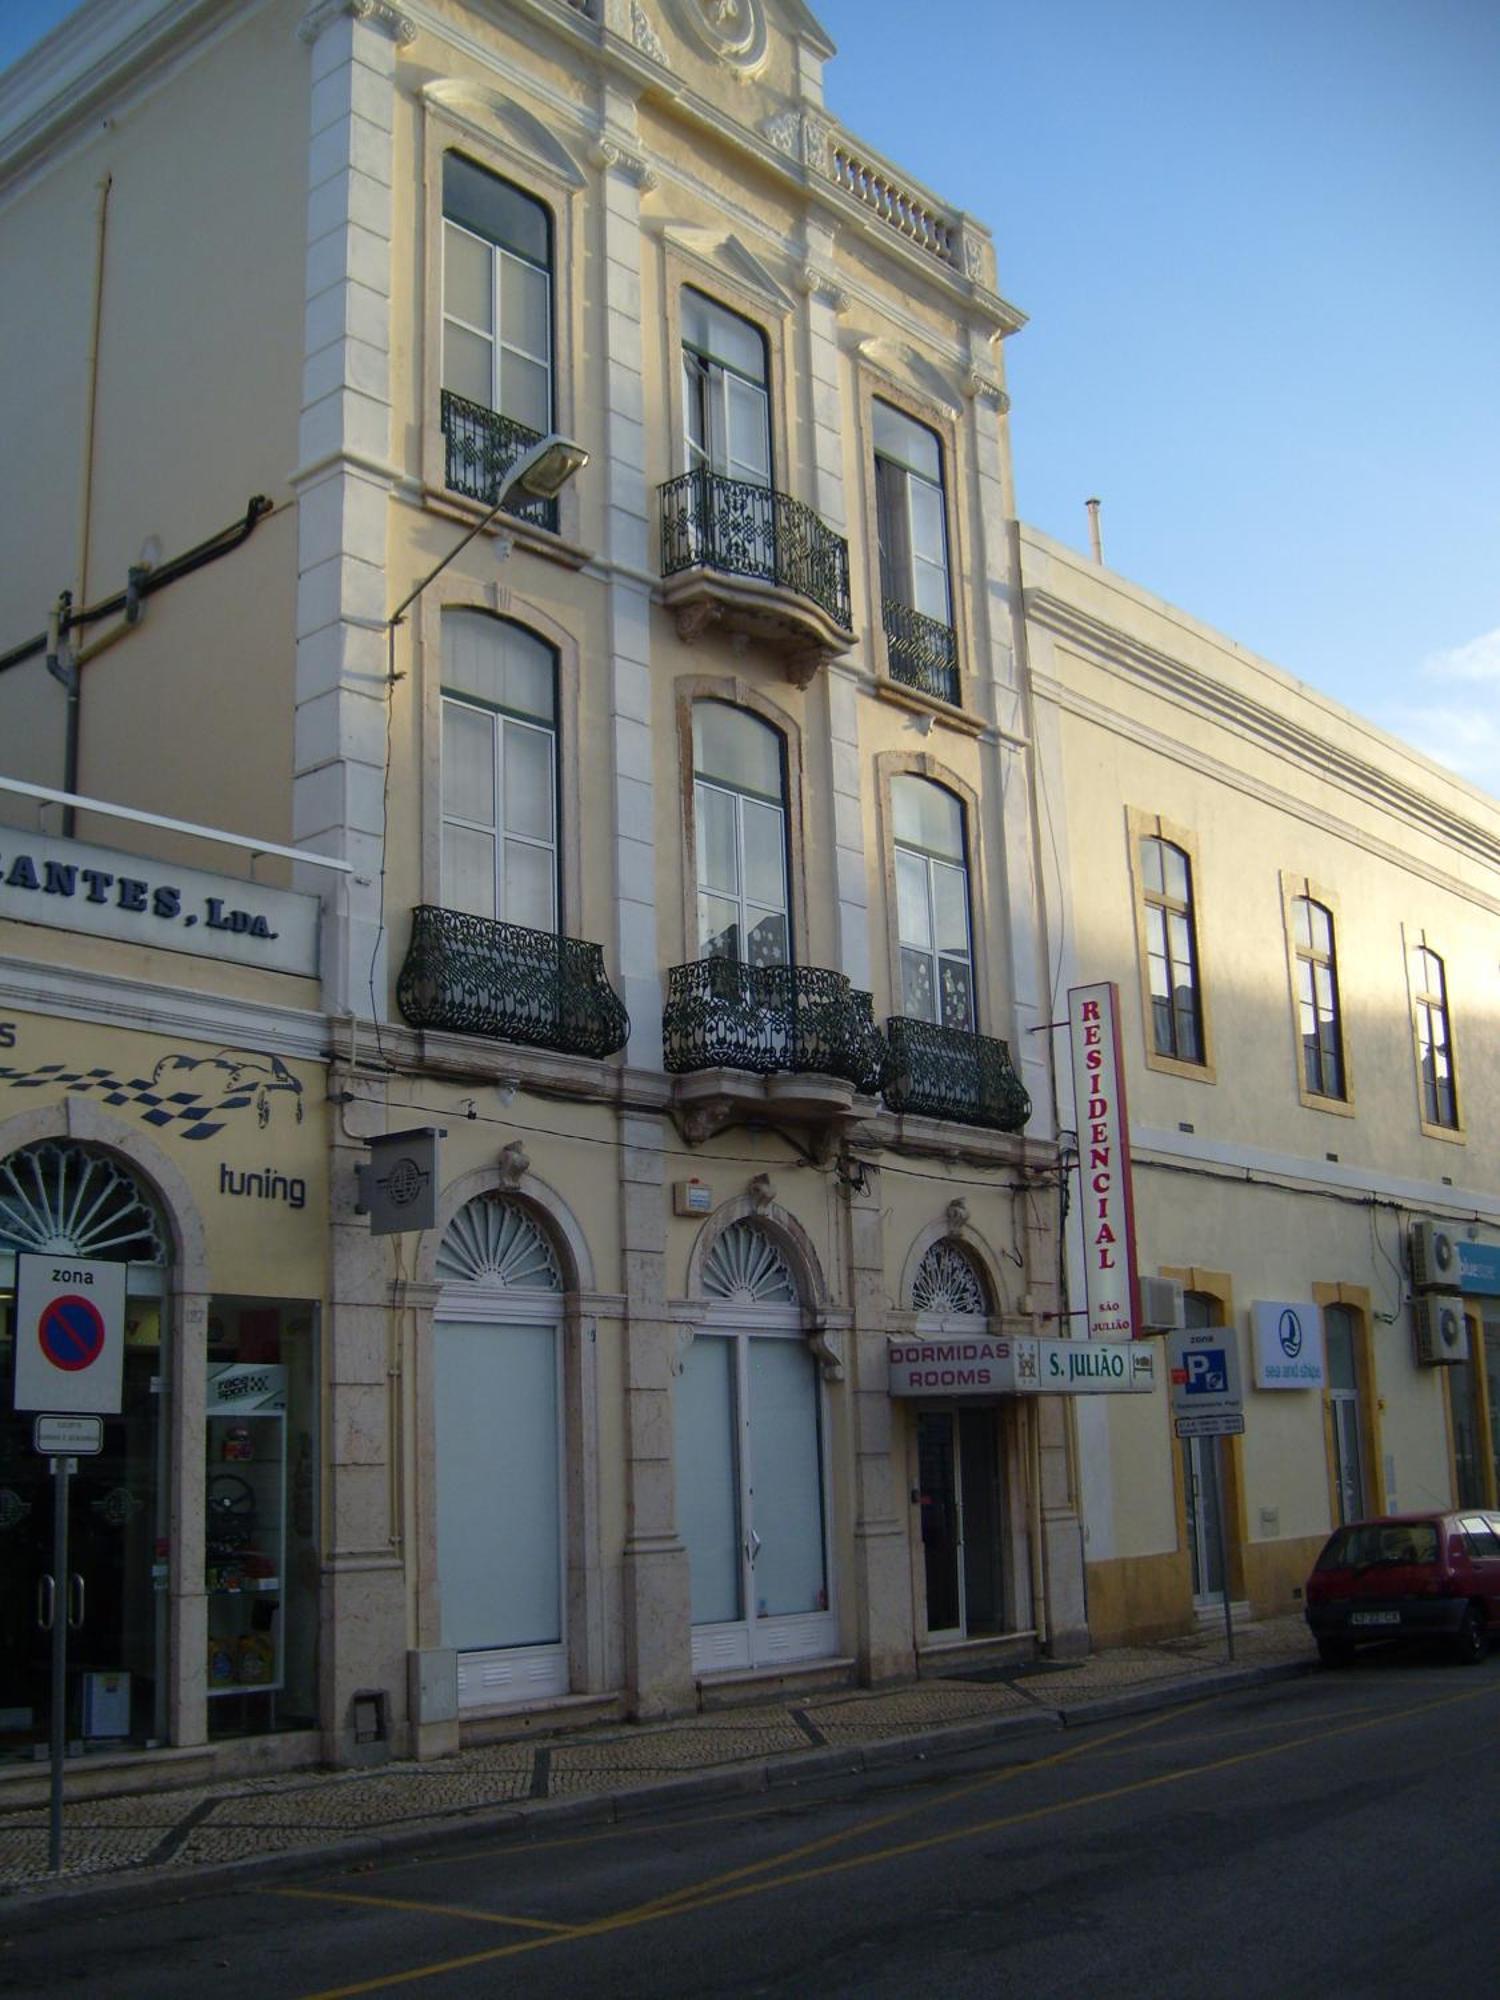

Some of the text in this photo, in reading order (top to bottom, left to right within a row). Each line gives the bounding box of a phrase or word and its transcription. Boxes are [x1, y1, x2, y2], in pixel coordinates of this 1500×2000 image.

[1081, 999, 1117, 1271] RESIDENCIAL
[220, 1163, 306, 1209] tuning
[52, 1268, 94, 1285] zona
[1099, 1302, 1120, 1312] SÃO
[1091, 1319, 1130, 1332] JULIÃO
[1190, 1336, 1214, 1344] zona
[889, 1342, 1010, 1366] DORMIDAS
[1050, 1348, 1124, 1382] S. JULIÃO
[1282, 1363, 1298, 1378] and
[909, 1368, 992, 1388] ROOMS
